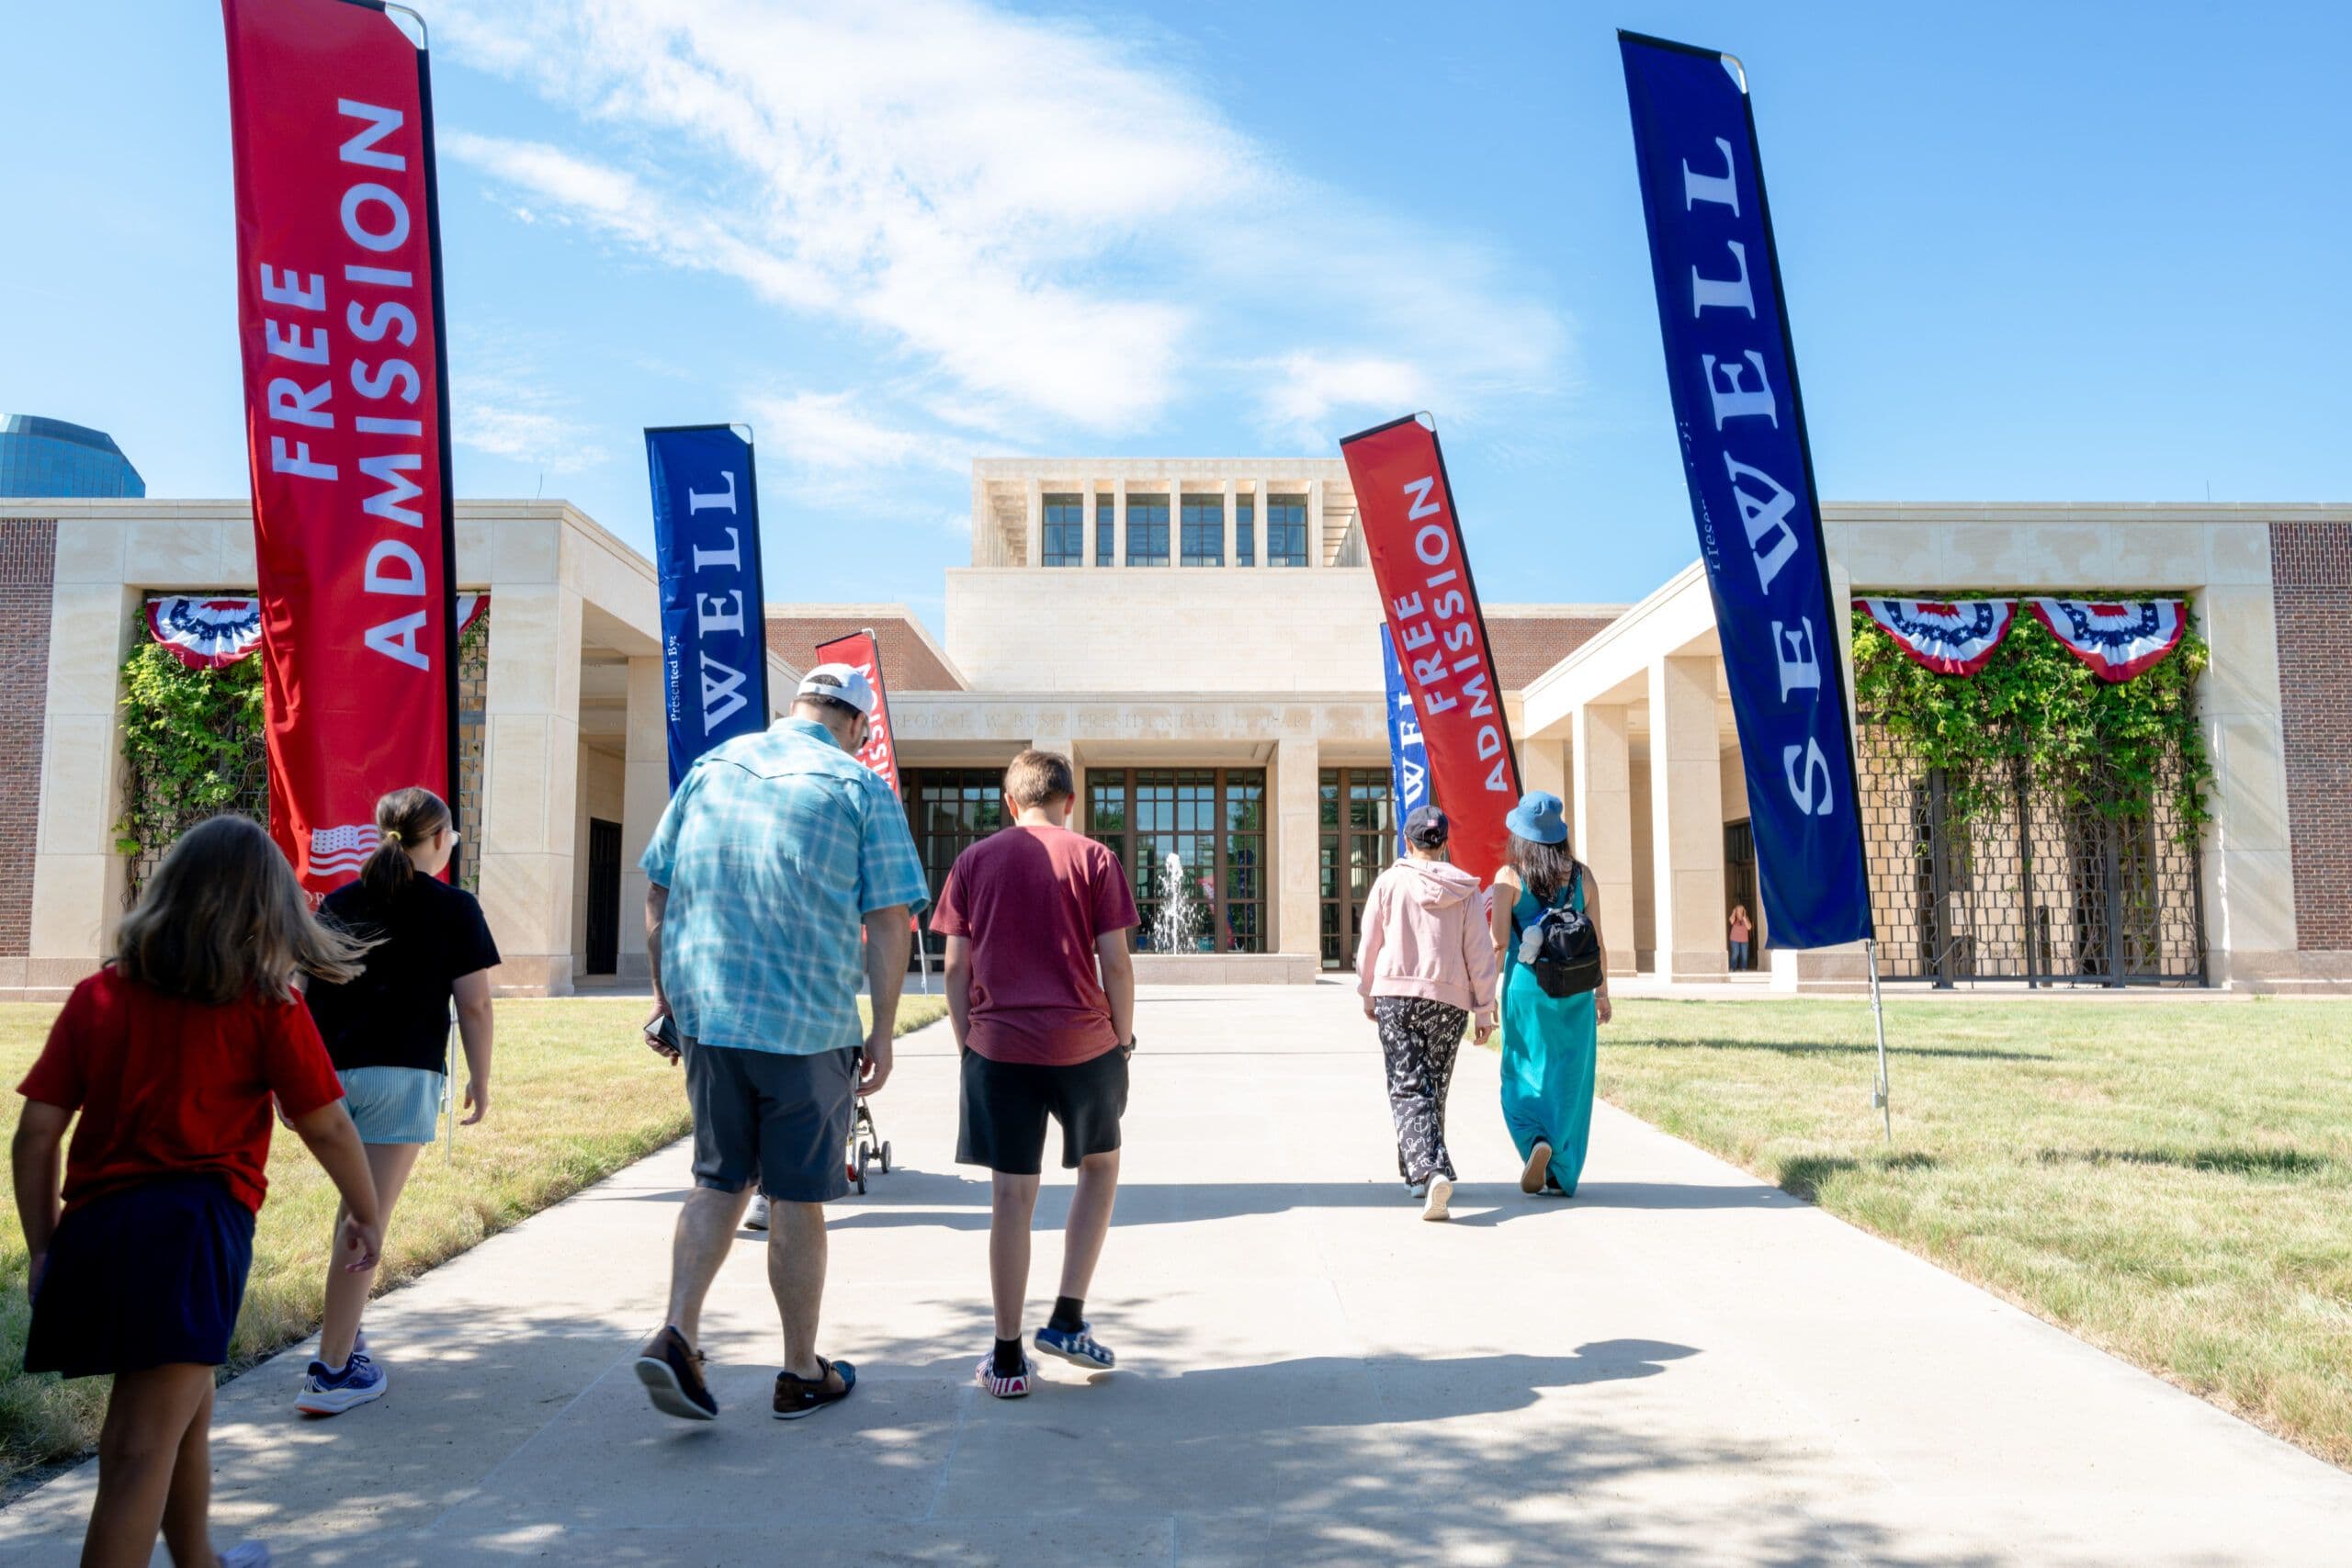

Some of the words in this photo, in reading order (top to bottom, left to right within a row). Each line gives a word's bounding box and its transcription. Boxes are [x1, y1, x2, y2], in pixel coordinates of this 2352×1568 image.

[260, 263, 339, 480] FREE
[337, 97, 430, 671] ADMISSION
[1682, 136, 1834, 816] SEWELL
[667, 635, 681, 656] By:
[669, 660, 682, 722] Presented
[689, 470, 749, 737] WELL
[1393, 591, 1459, 716] FREE
[1403, 475, 1509, 792] ADMISSION
